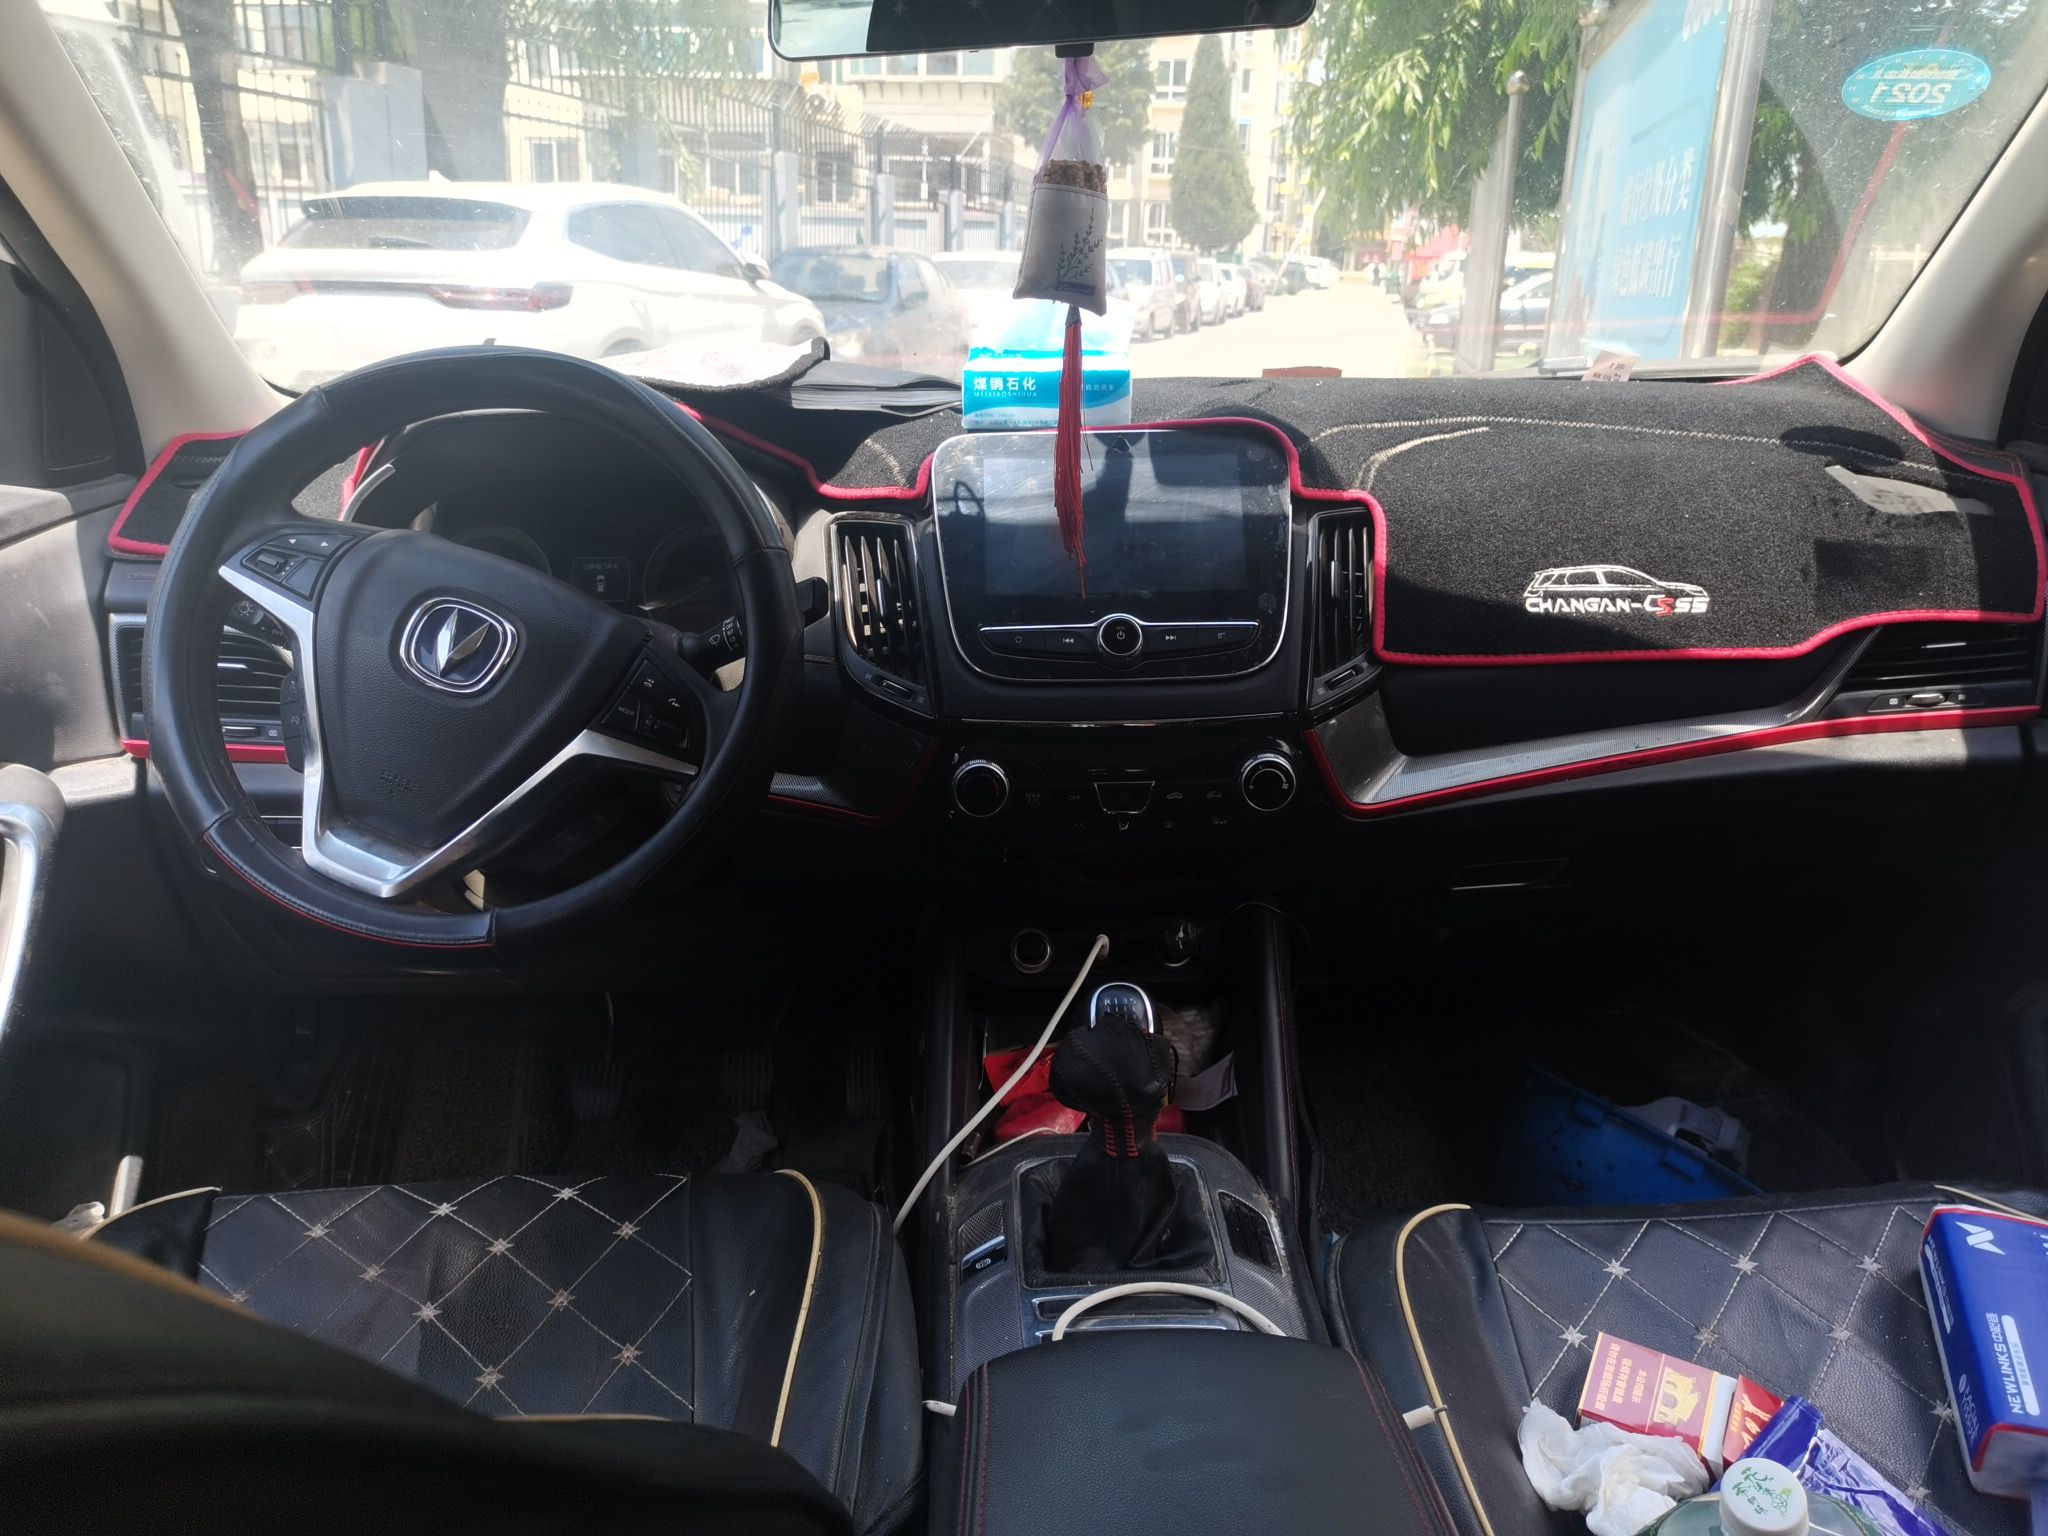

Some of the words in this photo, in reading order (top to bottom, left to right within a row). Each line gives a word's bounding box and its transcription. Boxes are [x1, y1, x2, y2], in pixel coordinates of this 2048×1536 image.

[973, 376, 1037, 391] 煤销石化
[618, 706, 635, 716] MODE
[1104, 997, 1111, 1005] R
[1994, 1342, 2024, 1415] NEWLINKS
